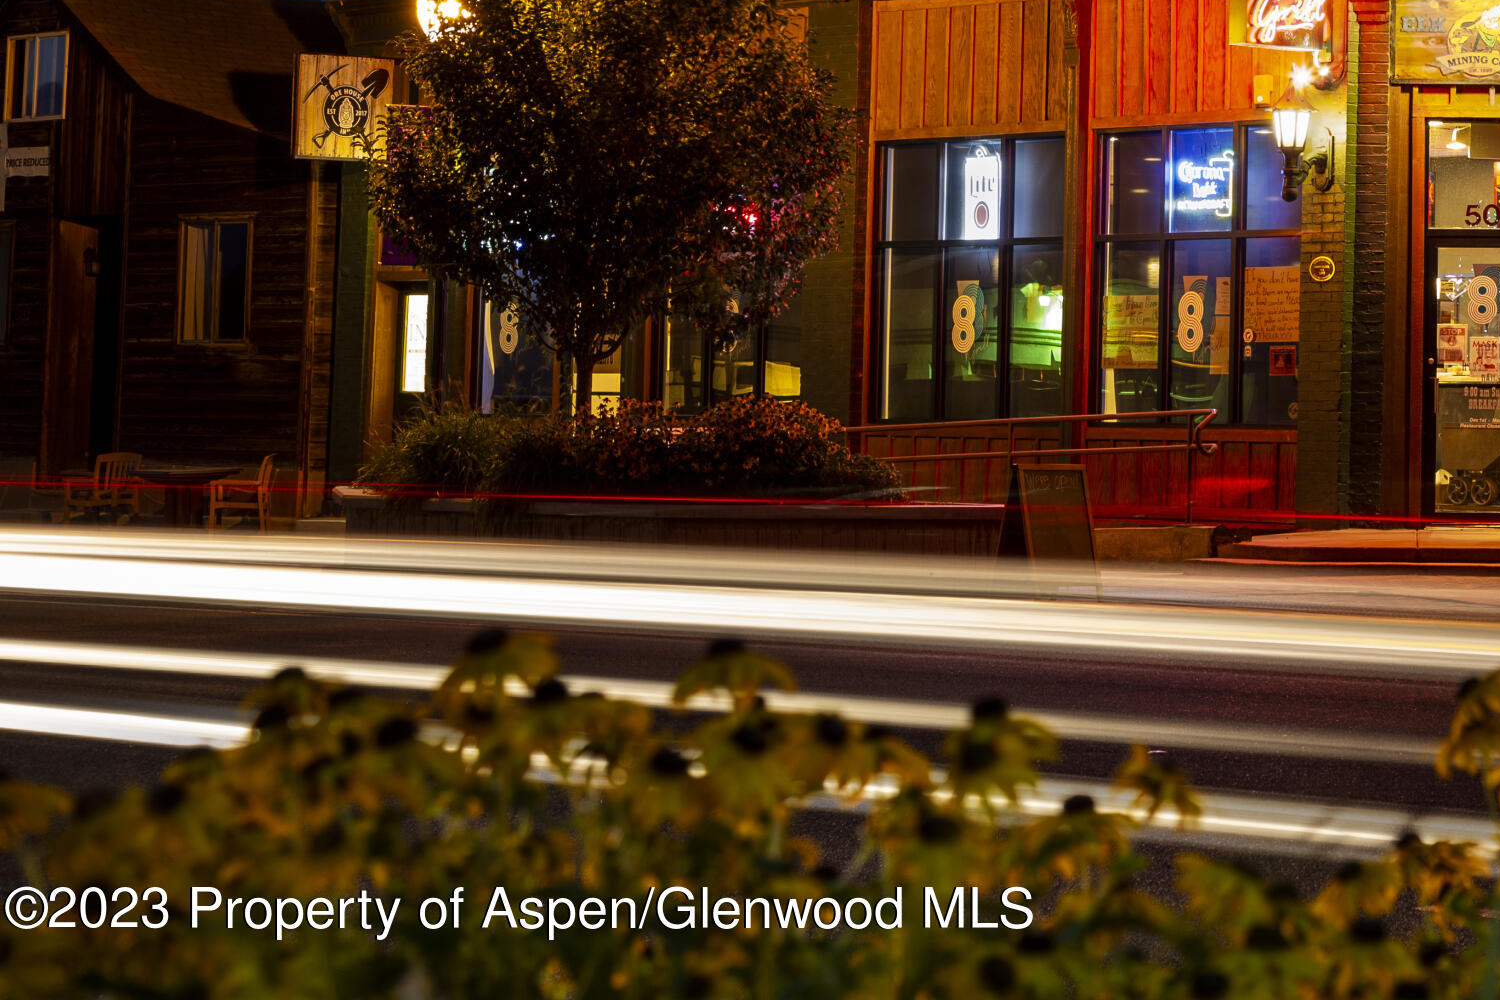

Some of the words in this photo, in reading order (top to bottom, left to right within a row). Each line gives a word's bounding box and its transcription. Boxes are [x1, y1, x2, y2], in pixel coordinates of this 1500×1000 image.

[1400, 15, 1447, 33] ELK
[1447, 55, 1489, 67] MINING
[331, 88, 343, 101] ORE
[343, 88, 365, 102] HOUSE
[23, 157, 49, 167] REDUCED
[1178, 160, 1225, 184] Corona
[1472, 341, 1498, 349] MASK
[1480, 389, 1490, 397] am
